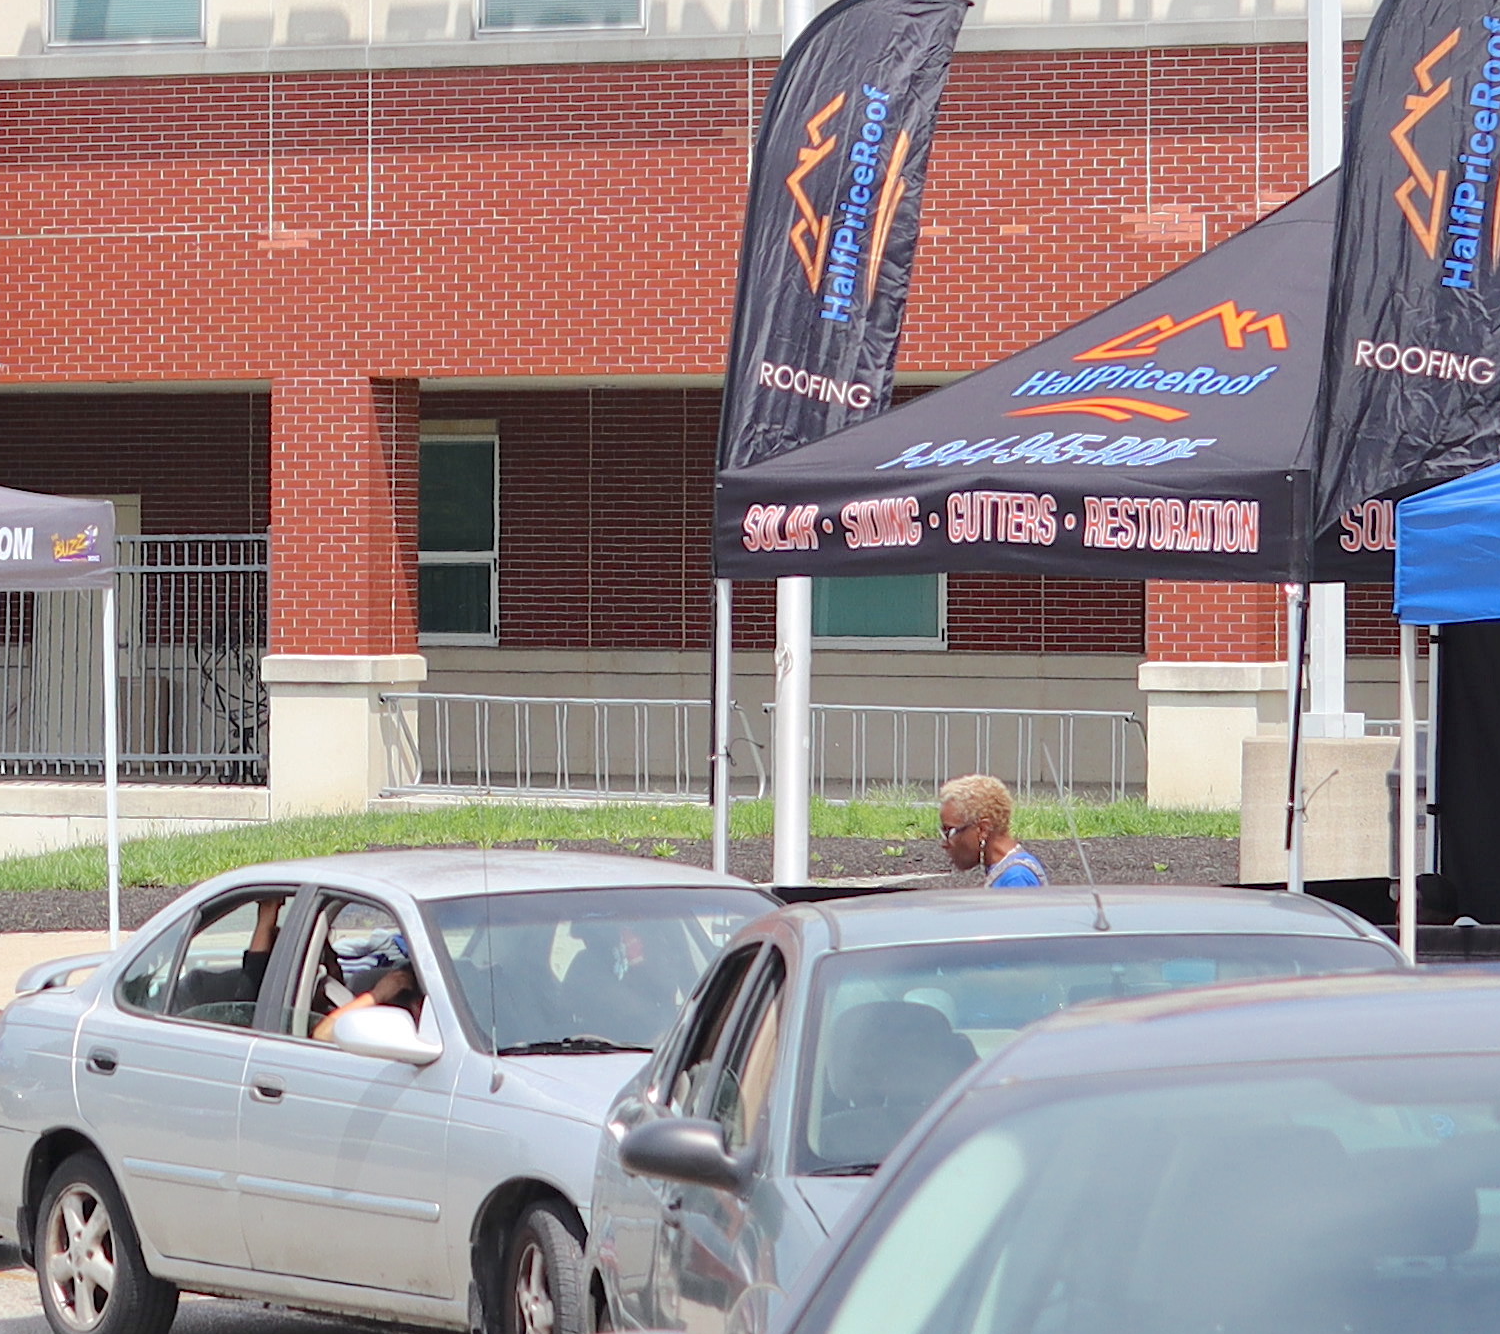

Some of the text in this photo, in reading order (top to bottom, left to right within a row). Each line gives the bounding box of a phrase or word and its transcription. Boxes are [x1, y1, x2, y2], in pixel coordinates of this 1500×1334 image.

[820, 83, 891, 323] HalfPriceRoof
[758, 361, 871, 409] ROOFING
[1010, 361, 1278, 398] HalfPriceRoof
[1354, 339, 1496, 385] ROOFING
[741, 490, 1260, 554] SOLAR SIDING GUTTERS RESTORATION
